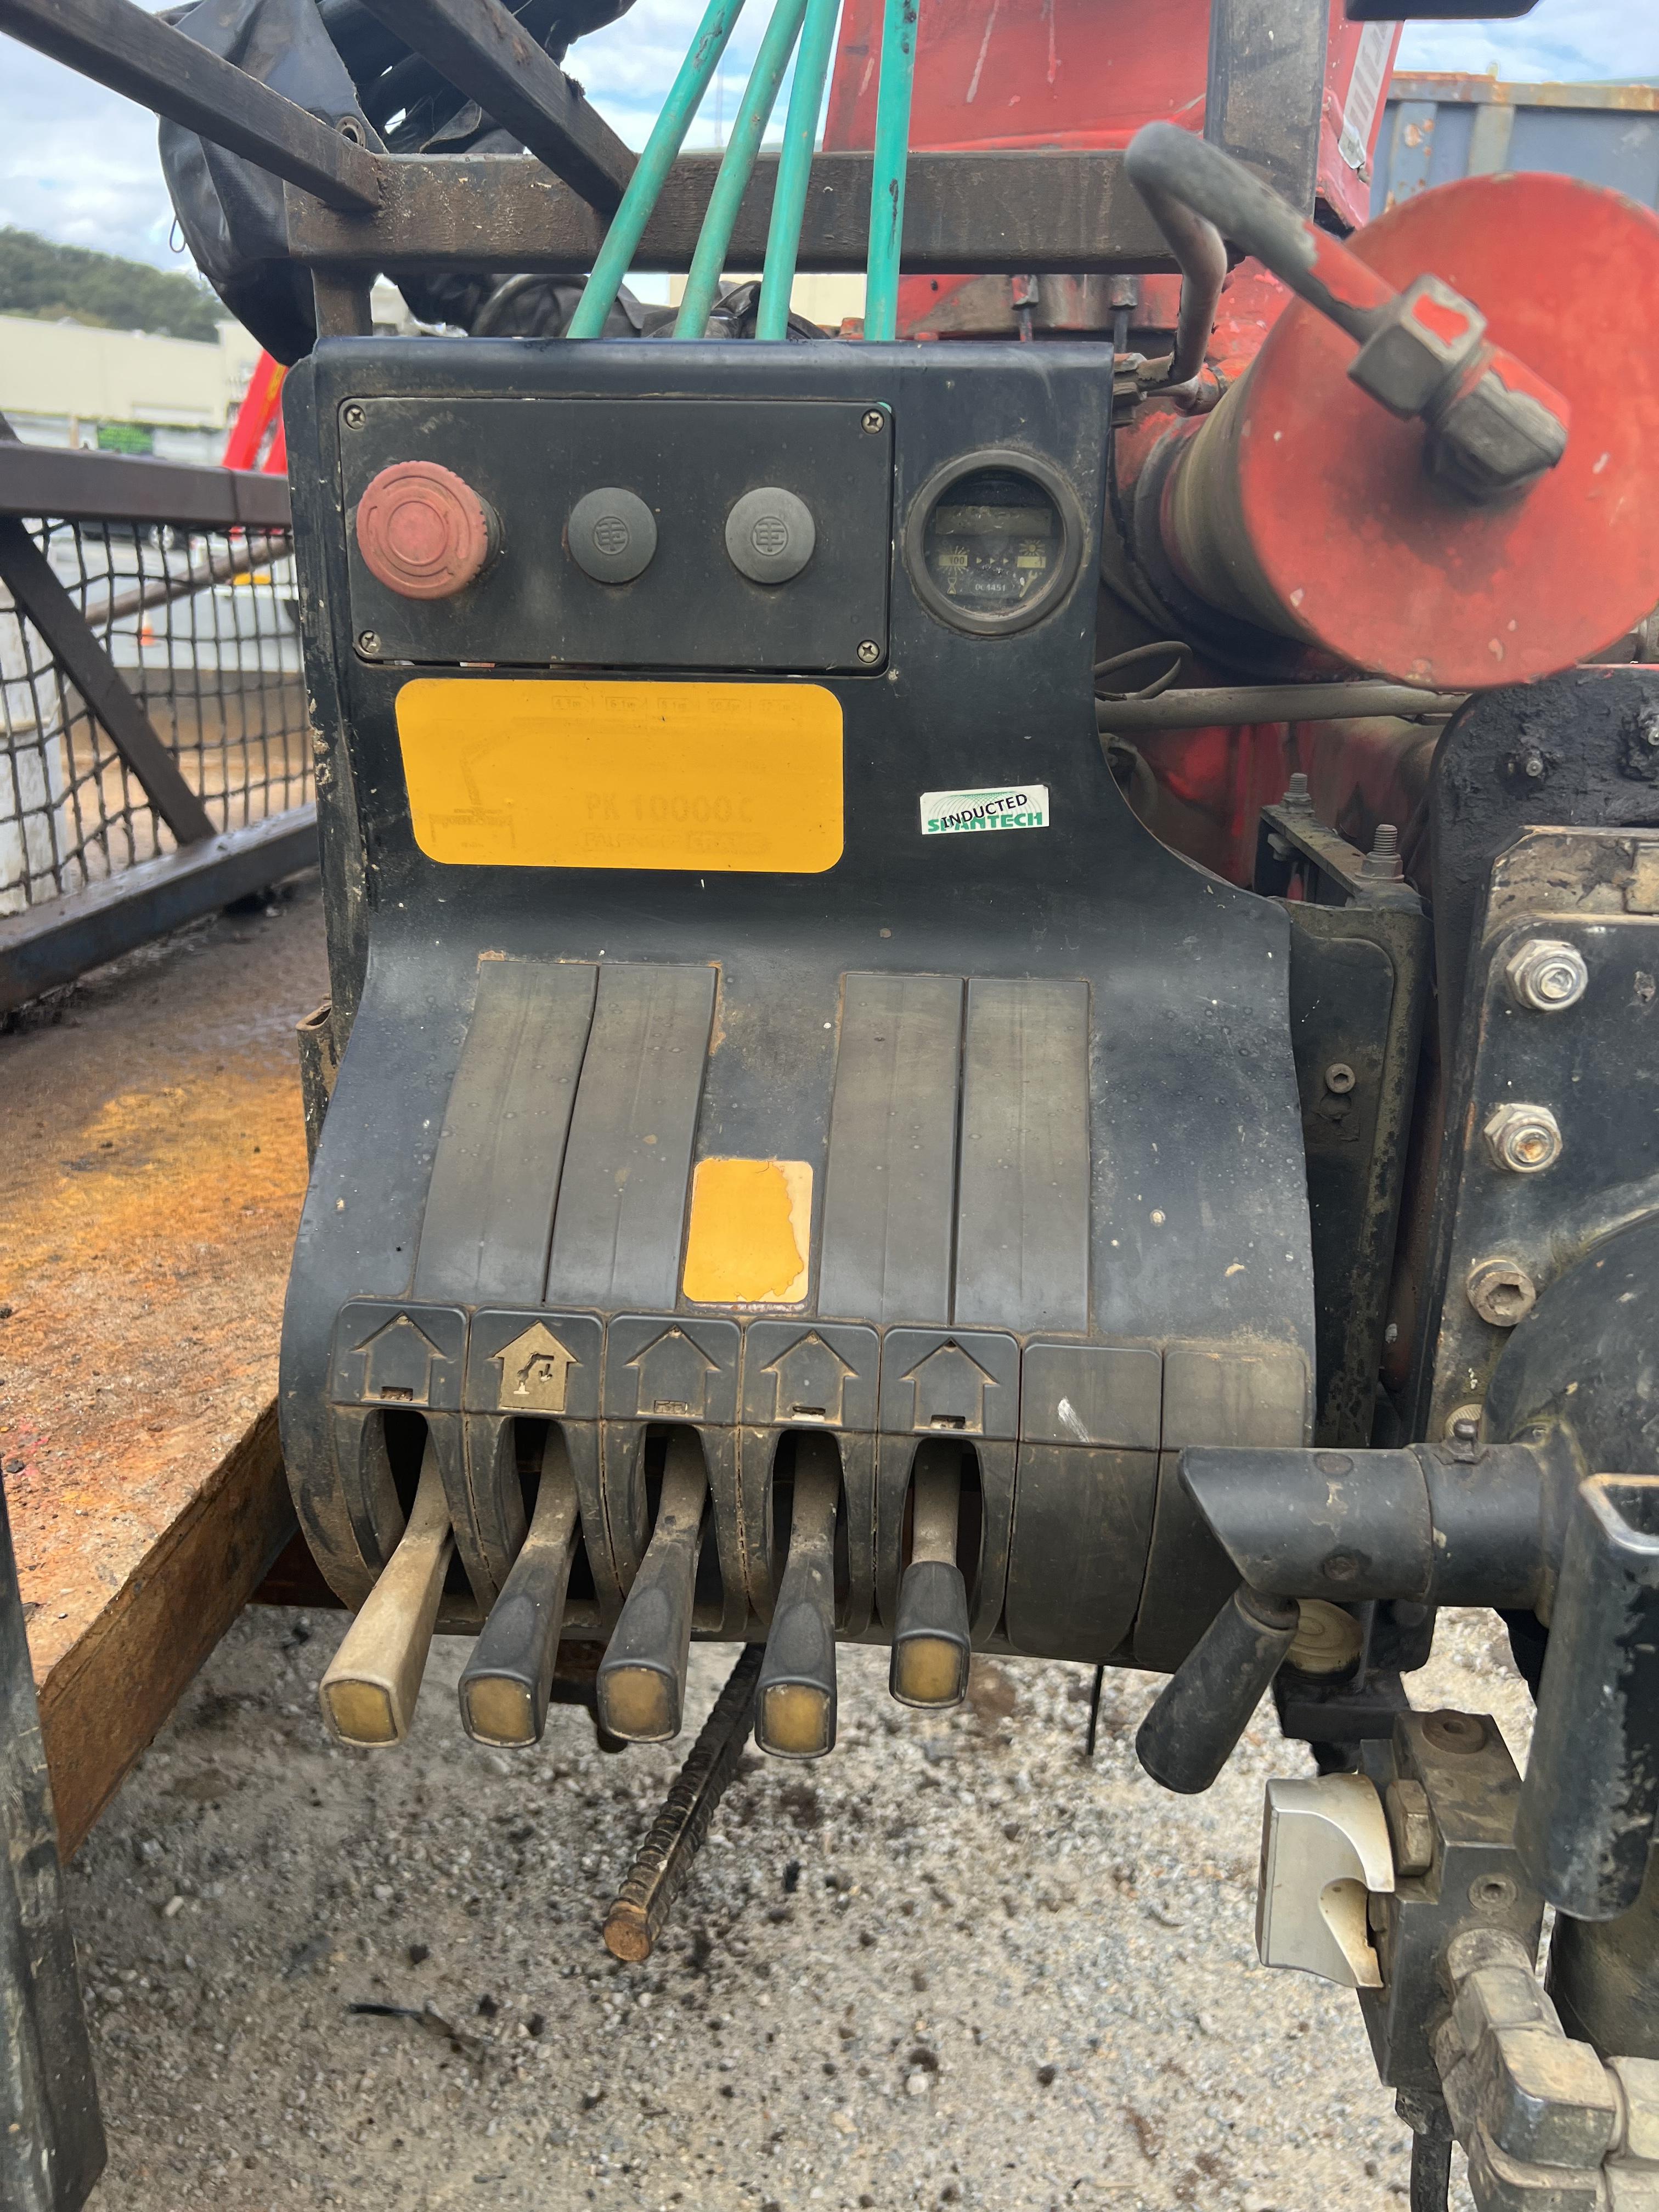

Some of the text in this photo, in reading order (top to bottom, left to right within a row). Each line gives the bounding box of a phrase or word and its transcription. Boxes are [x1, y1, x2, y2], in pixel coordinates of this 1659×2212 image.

[585, 791, 619, 821] PK
[941, 794, 1028, 828] INDUCTED
[928, 812, 1042, 832] SPANTECH
